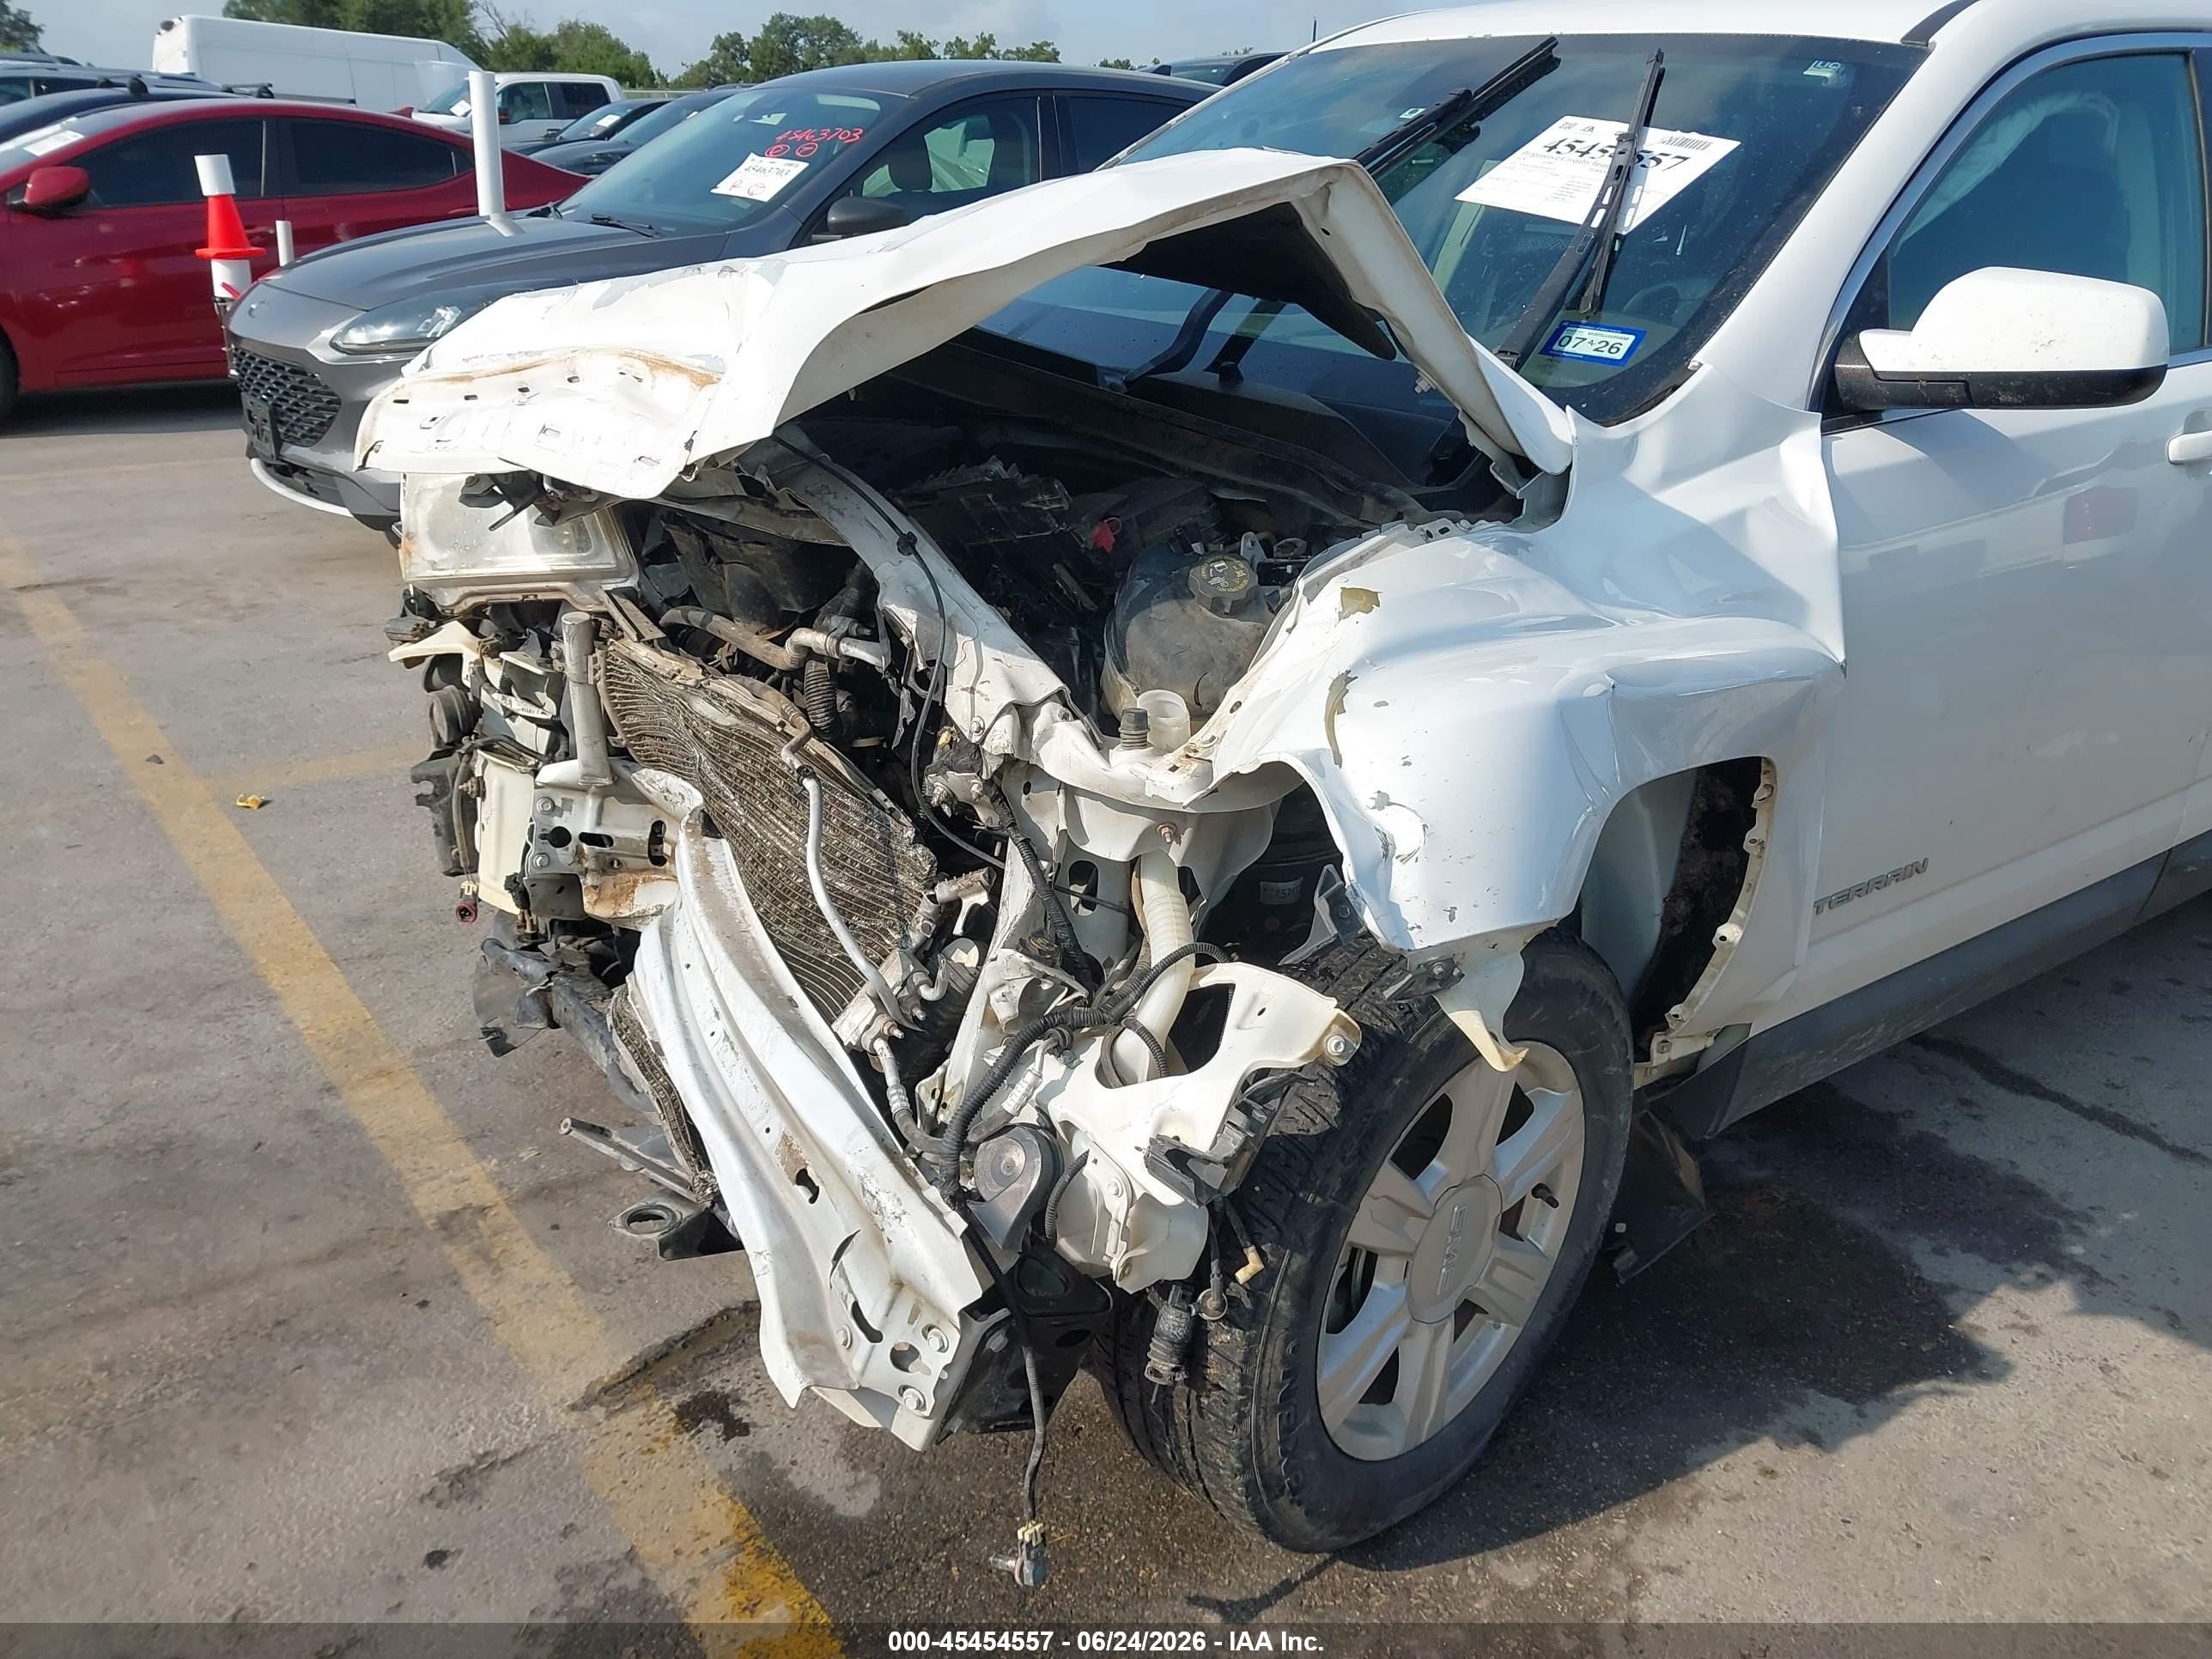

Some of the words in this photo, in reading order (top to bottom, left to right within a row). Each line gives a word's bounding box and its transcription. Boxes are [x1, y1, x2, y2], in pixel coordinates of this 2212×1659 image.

[1543, 137, 1692, 172] 4545557
[1558, 335, 1588, 349] 07
[1593, 340, 1623, 355] 26
[1814, 857, 1929, 915] TERRAIN
[1436, 1204, 1469, 1296] GMC
